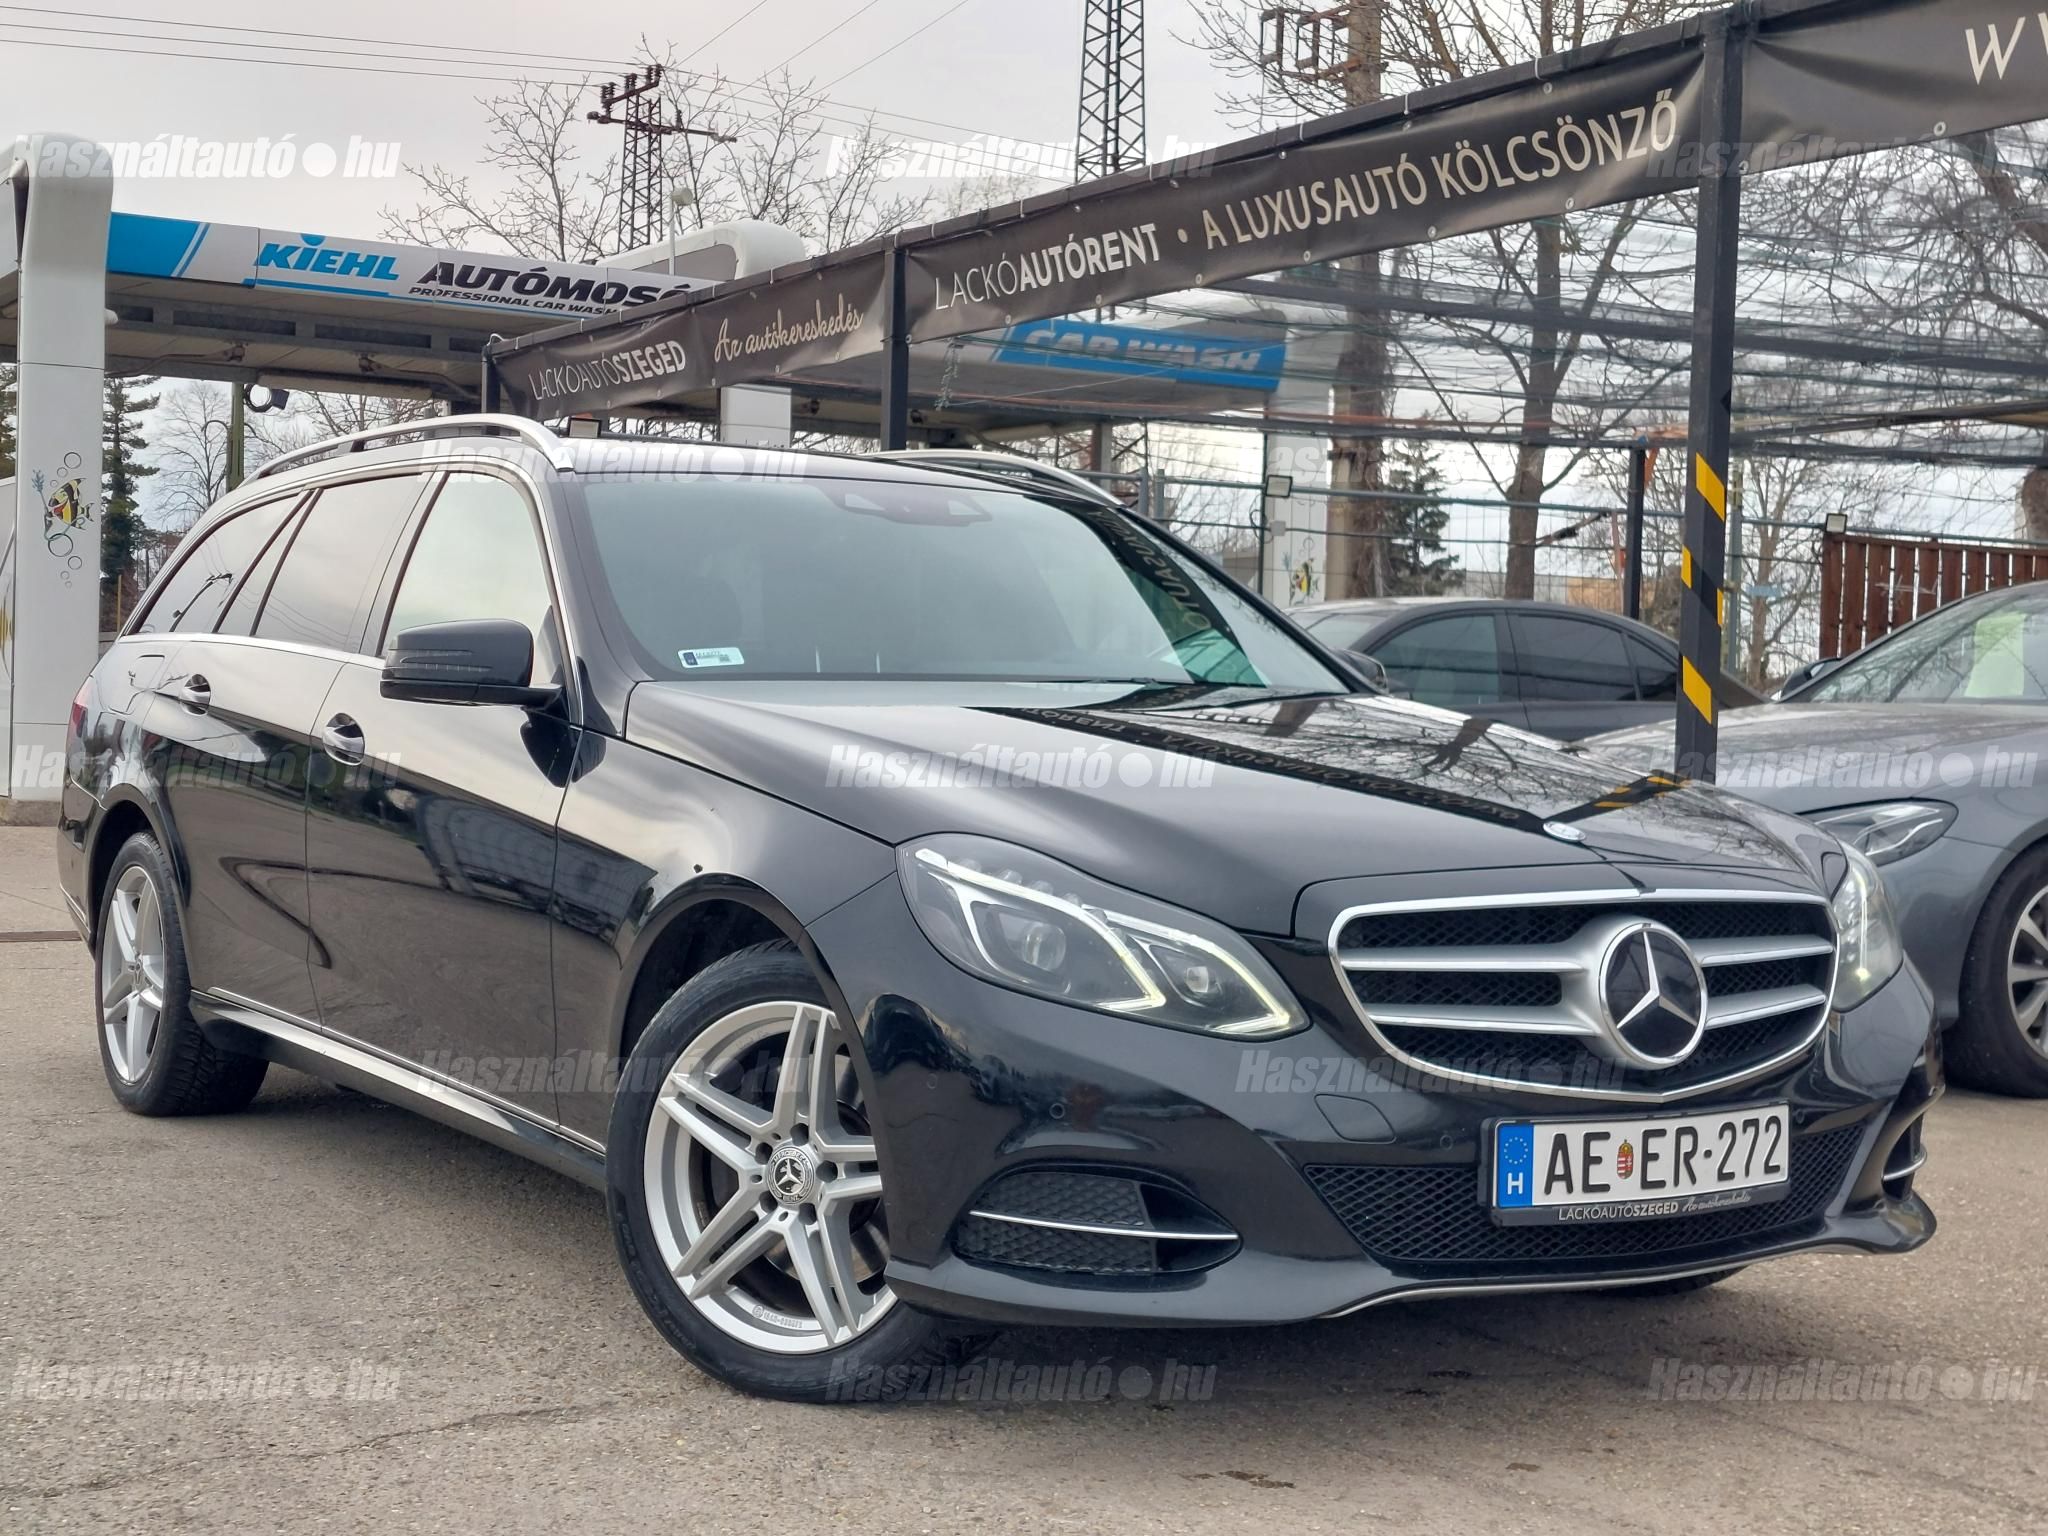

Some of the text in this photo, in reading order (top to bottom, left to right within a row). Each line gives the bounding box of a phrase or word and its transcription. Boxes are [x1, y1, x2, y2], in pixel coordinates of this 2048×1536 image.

[1202, 209, 1227, 250] A
[1232, 154, 1428, 243] LUXUSAUTÓ
[1430, 90, 1678, 198] KÖLCSÖNZŐ
[408, 286, 530, 307] PROFESSIONAL
[533, 301, 567, 311] CAR
[1507, 1173, 1523, 1194] H
[1544, 1131, 1611, 1195] AE
